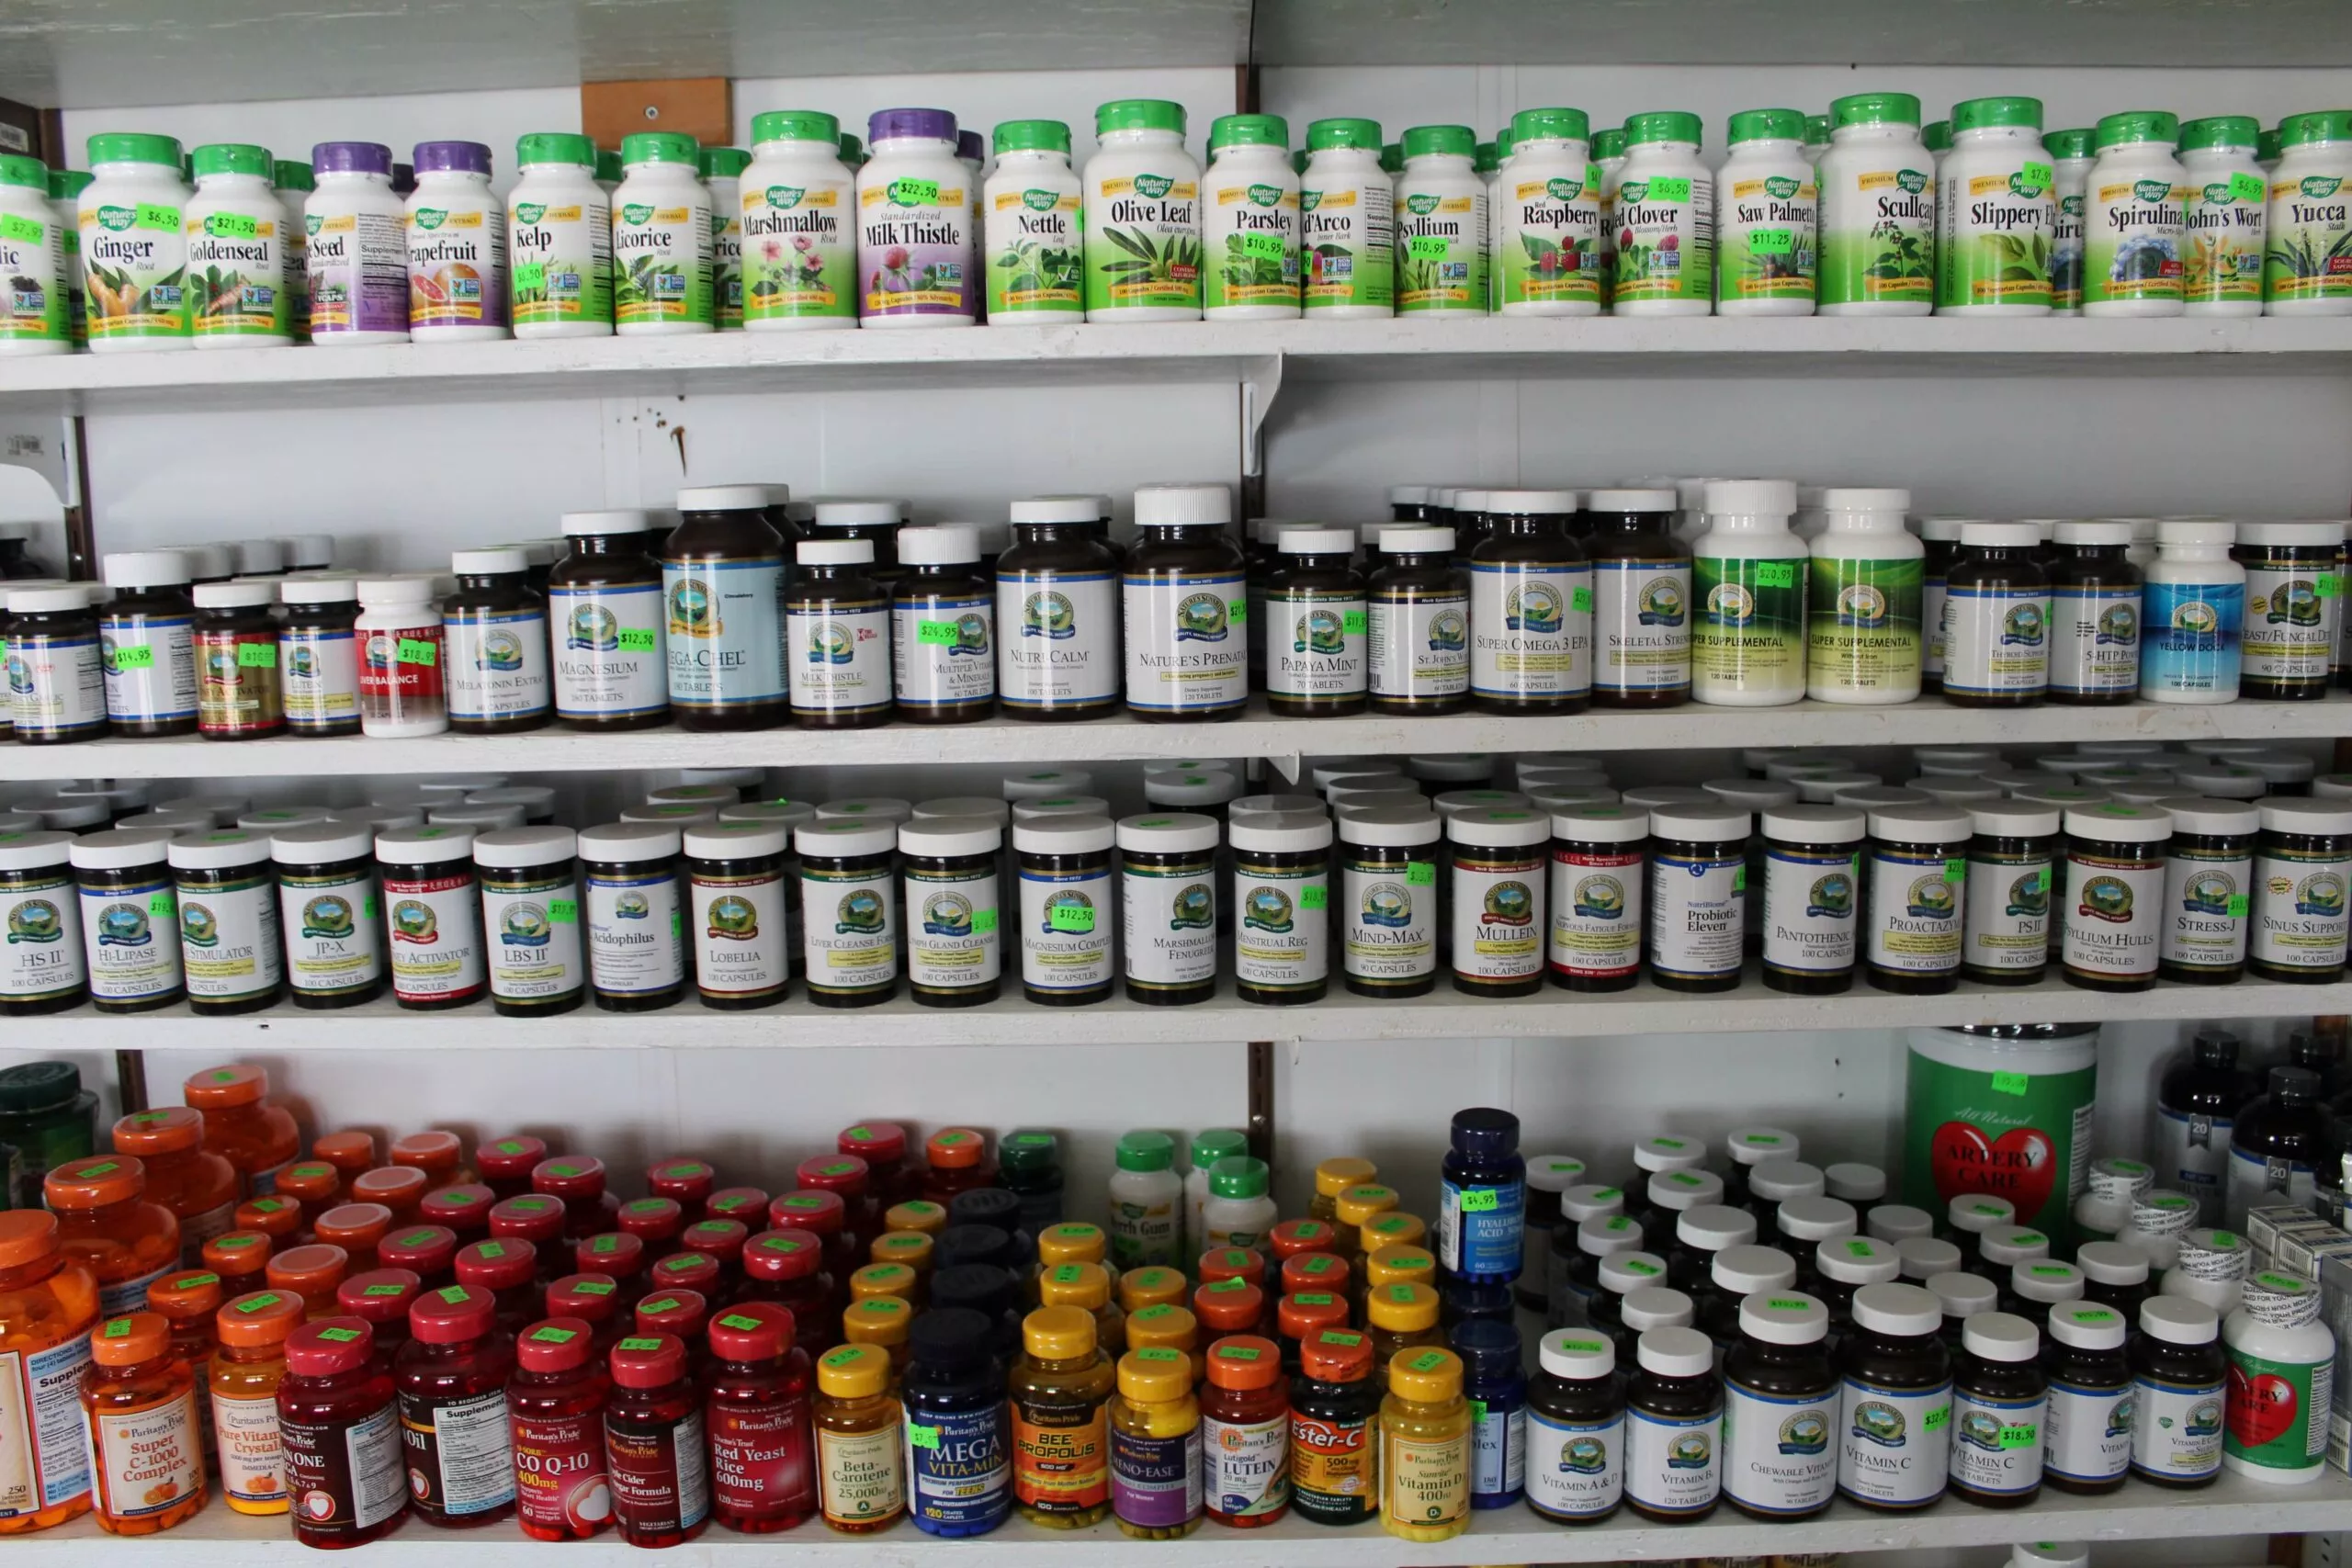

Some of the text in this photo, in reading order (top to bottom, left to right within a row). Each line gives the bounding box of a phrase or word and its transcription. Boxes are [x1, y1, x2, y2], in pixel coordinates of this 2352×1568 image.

[900, 183, 937, 198] $22.50
[1657, 183, 1689, 195] $6.50
[1112, 200, 1192, 224] Olive Leaf
[1534, 201, 1546, 209] Red
[147, 211, 178, 227] $6.50
[880, 211, 941, 221] Standardized
[1628, 206, 1678, 226] Clover
[1971, 203, 2041, 230] Slippery
[2109, 205, 2183, 228] Spirulina
[2292, 205, 2346, 223] Yucca
[217, 217, 255, 233] $21.50
[744, 209, 838, 238] Marshmallow
[1018, 216, 1065, 234] Nettle
[1236, 210, 1292, 237] Parsley
[1305, 215, 1351, 232] d'Arco
[865, 224, 959, 247] Milk Thistle
[1396, 218, 1459, 244] Psyllium
[517, 229, 551, 251] Kelp
[1246, 236, 1282, 253] $10.95
[1752, 233, 1789, 245] $11.25
[95, 238, 153, 265] Ginger
[190, 242, 268, 262] Goldenseal
[1411, 241, 1445, 254] $10.95
[922, 626, 956, 637] $24.95
[620, 634, 653, 645] $12.50
[1477, 636, 1588, 651] SUPER OMEGA 3 EPA
[1610, 635, 1664, 648] SKELETAL
[1708, 635, 1783, 649] SUPPLEMENTAL
[1812, 636, 1912, 647] SUPER SUPPLEMENTAL
[2159, 642, 2225, 652] YELLOW DOCK
[118, 649, 151, 663] $14.95
[2086, 651, 2118, 660] 5-HTP
[560, 661, 638, 674] MAGNESIUM
[935, 664, 972, 673] MULTIPLE
[1281, 658, 1358, 671] PAPAYA MINT
[2261, 664, 2320, 674] 90 CAPSULES
[801, 671, 862, 682] MILK THISTLE
[1297, 680, 1344, 689] 70 TABLETS
[1520, 681, 1558, 689] CAPSULES
[1059, 908, 1092, 921] $12.50
[1688, 908, 1737, 920] Probiotic
[1585, 921, 1615, 931] FATIGUE
[1688, 920, 1727, 932] Eleven
[2177, 917, 2235, 932] STRESS-J
[594, 932, 655, 944] Acidophilus
[1238, 933, 1307, 947] MENSTRUAL REG
[1352, 930, 1422, 944] MIND-MAX
[1476, 926, 1537, 941] MULLEIN
[1777, 926, 1850, 943] PANTOTHENIC
[2116, 931, 2154, 946] HULLS
[315, 941, 345, 955] JP-X
[811, 937, 876, 948] LIVER CLEANSE
[929, 936, 996, 948] GLAND CLEANSE
[1024, 938, 1076, 952] MAGNESIUM
[21, 951, 62, 966] HS II
[98, 947, 157, 962] HI-LIPASE
[189, 946, 253, 960] STIMULATOR
[409, 948, 469, 963] ACTIVATOR
[710, 951, 761, 964] LOBELIA
[2073, 951, 2135, 965] 100 CAPSULES
[2174, 953, 2234, 962] 100 CAPSULES
[1585, 956, 1626, 965] CAPSULES
[1254, 969, 1299, 978] CAPSULES
[1371, 964, 1417, 972] CAPSULES
[1477, 965, 1536, 976] 100 CAPSULES
[11, 972, 74, 987] 100 CAPSULES
[720, 971, 766, 980] CAPSULES
[833, 971, 890, 983] 100 CAPSULES
[934, 973, 979, 981] CAPSULES
[1057, 971, 1098, 981] CAPSULES
[2193, 1122, 2207, 1134] 20
[1947, 1145, 2038, 1168] ARTERY
[1958, 1167, 2020, 1189] CARE
[2270, 1168, 2286, 1179] 20
[1468, 1194, 1494, 1205] $4.95
[1477, 1229, 1503, 1237] ACID
[447, 1397, 504, 1418] Supplement
[406, 1431, 426, 1450] Oil
[526, 1427, 580, 1441] Puritan's Pride
[1038, 1434, 1072, 1446] BEE
[1292, 1422, 1358, 1448] Ester-C
[2003, 1428, 2034, 1440] $18.50
[130, 1433, 174, 1454] Super
[929, 1438, 1001, 1462] MEGA
[1019, 1442, 1094, 1457] PROPOLIS
[130, 1447, 178, 1470] C-1000
[714, 1445, 786, 1461] Red Yeast
[1224, 1453, 1257, 1463] Lutigold
[1846, 1445, 1911, 1470] VITAMIN C
[1951, 1448, 2015, 1469] VITAMIN C
[301, 1455, 324, 1467] ONE
[516, 1452, 589, 1474] CO Q-10
[716, 1460, 744, 1474] Rice
[843, 1461, 878, 1472] Beta-
[929, 1452, 1002, 1475] VITA-MIN
[1224, 1459, 1275, 1474] LUTEIN
[123, 1456, 187, 1482] Complex
[832, 1466, 890, 1483] Carotene
[1751, 1462, 1804, 1477] CHEWABLE
[518, 1472, 559, 1489] 400mg
[622, 1475, 646, 1485] Cider
[716, 1472, 763, 1491] 600mg
[1543, 1474, 1587, 1491] VITAMIN
[1589, 1477, 1600, 1491] A
[1600, 1476, 1609, 1488] &
[1967, 1474, 2001, 1485] TABLETS
[8, 1484, 26, 1495] 250
[631, 1484, 671, 1496] Formula
[956, 1483, 985, 1495] TEENS
[718, 1494, 730, 1505] 120
[1037, 1502, 1051, 1511] 100
[1224, 1496, 1233, 1505] 60
[522, 1506, 534, 1516] 60
[925, 1508, 942, 1517] 120
